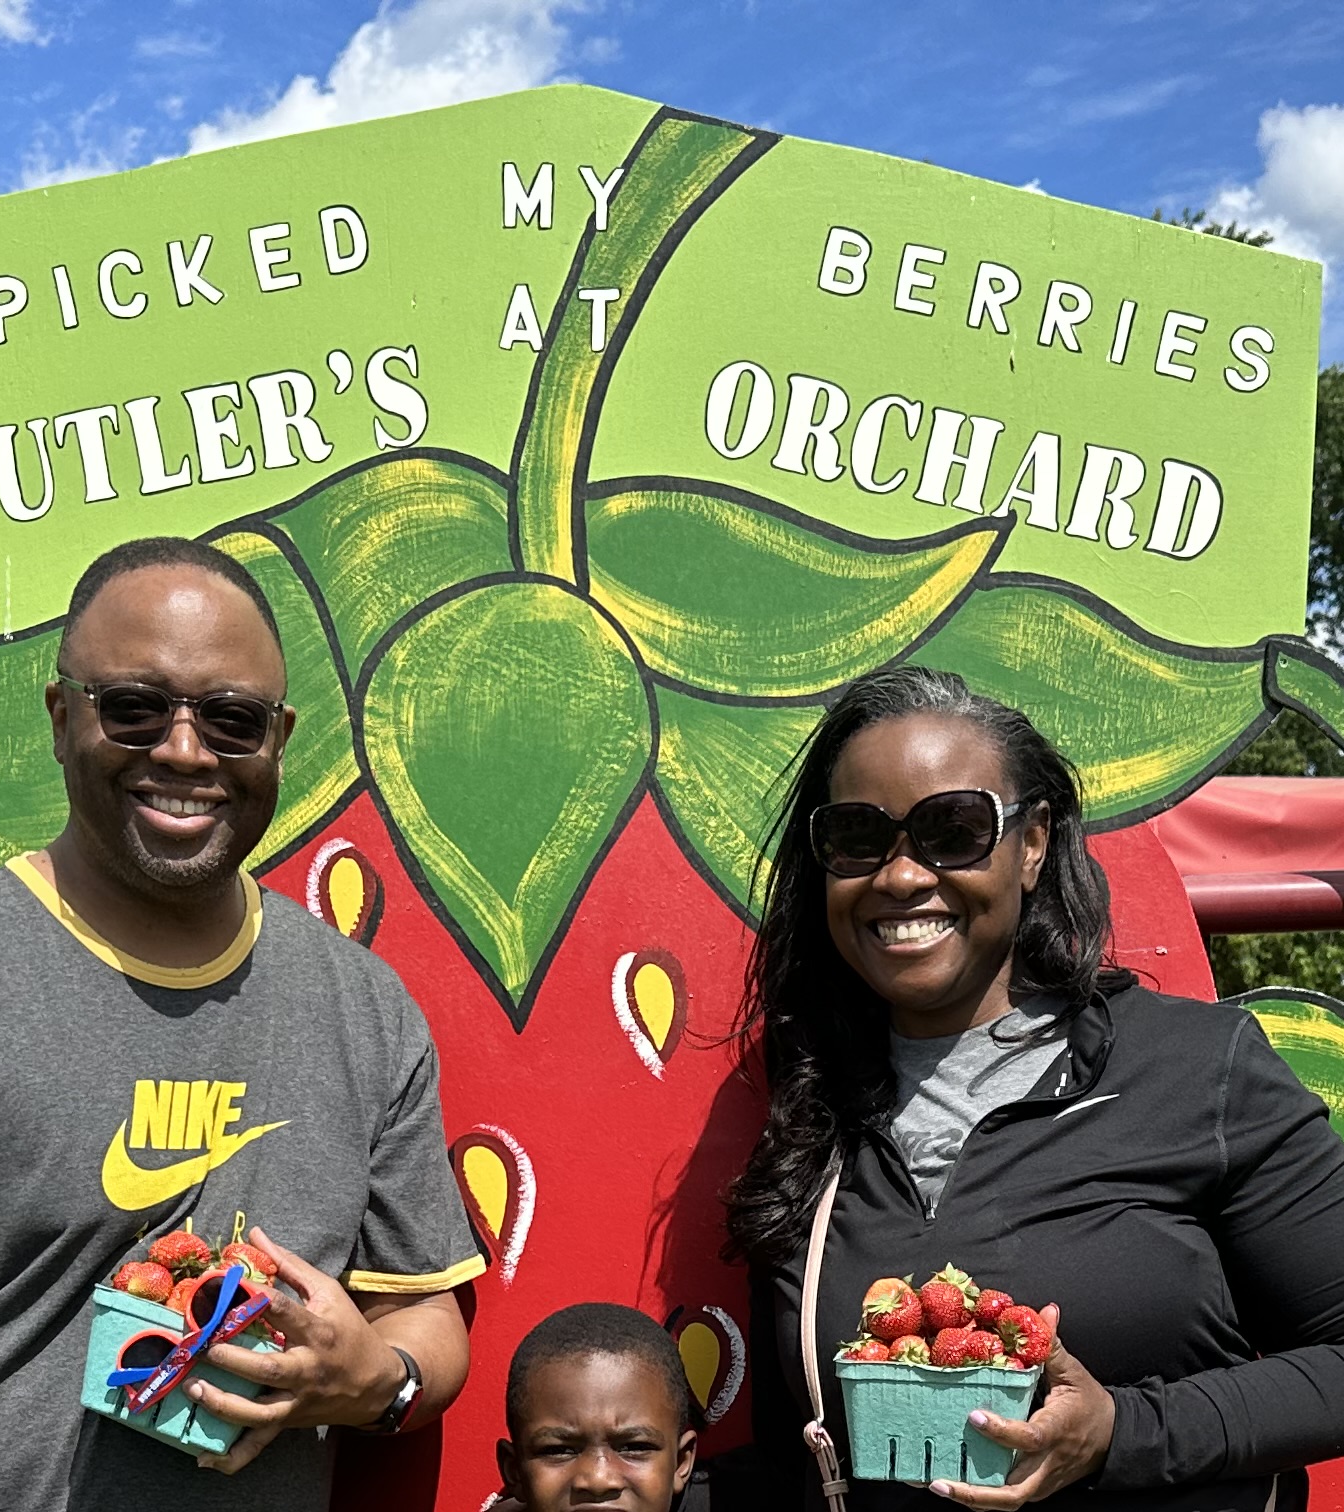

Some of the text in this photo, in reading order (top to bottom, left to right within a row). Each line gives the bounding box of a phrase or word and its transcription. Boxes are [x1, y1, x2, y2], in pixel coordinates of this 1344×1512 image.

[499, 284, 621, 352] AT
[501, 162, 626, 232] MY
[817, 226, 1275, 392] BERRIES
[705, 360, 1223, 561] ORCHARD
[129, 1079, 247, 1150] NIKE
